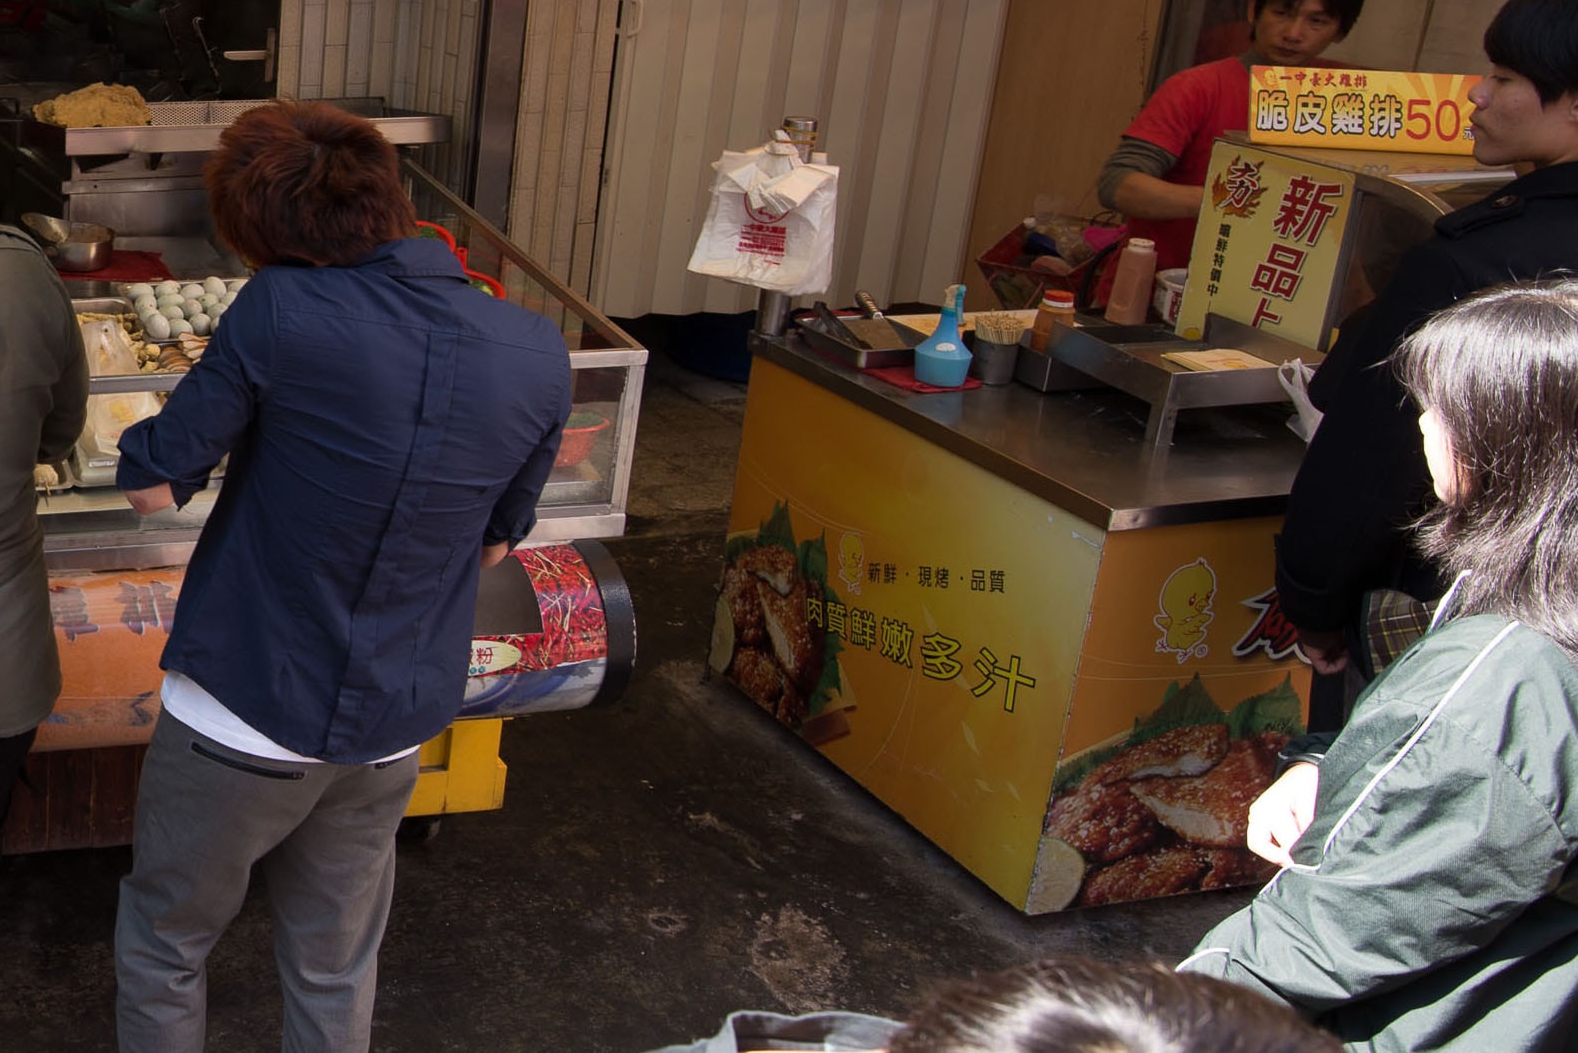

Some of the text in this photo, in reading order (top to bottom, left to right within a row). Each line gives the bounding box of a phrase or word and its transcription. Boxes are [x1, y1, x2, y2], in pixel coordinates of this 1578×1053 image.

[1279, 70, 1367, 89] 一中豪大雞排
[805, 596, 1036, 713] 肉質鮮嫩多汁
